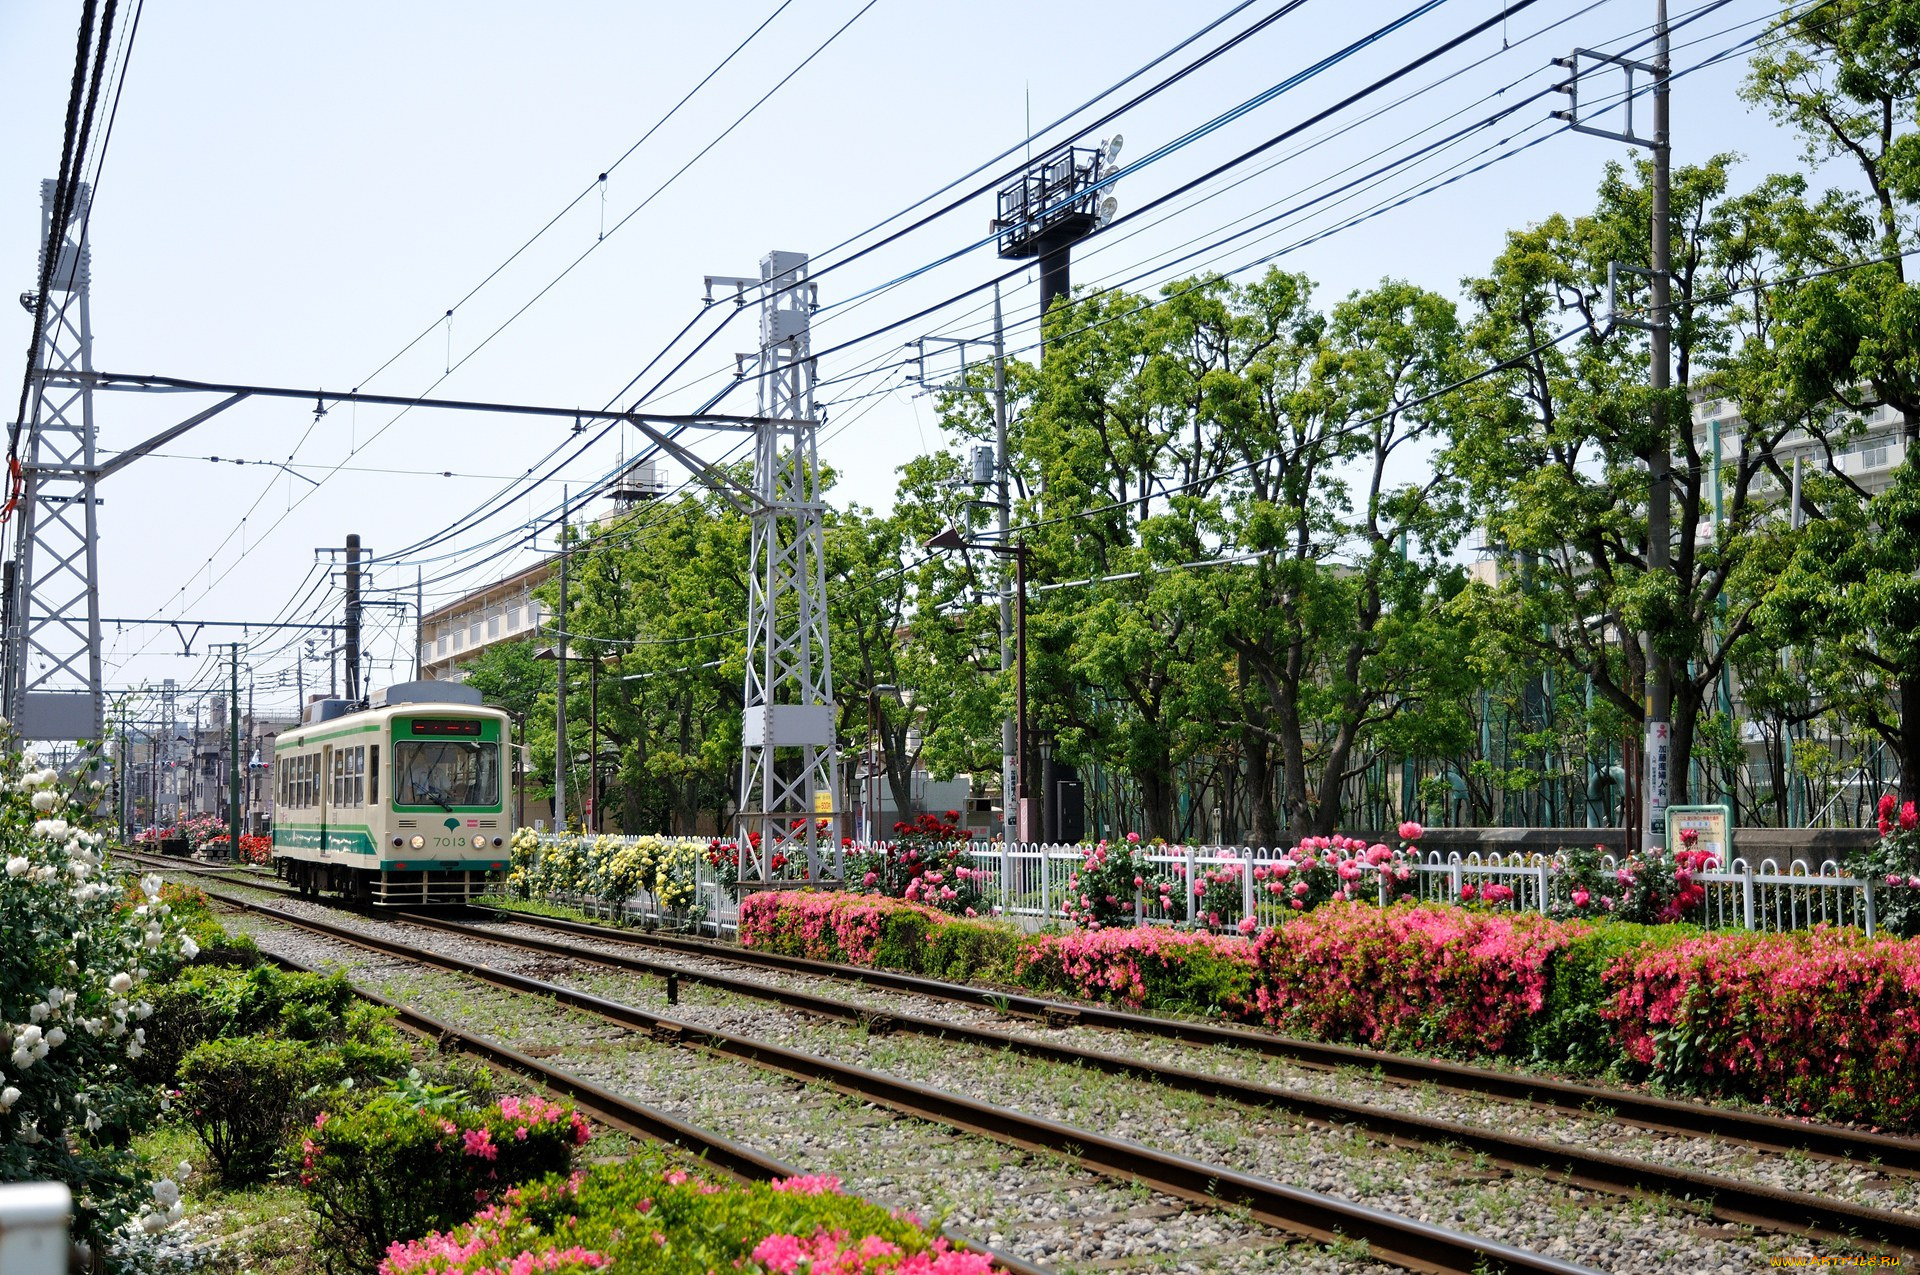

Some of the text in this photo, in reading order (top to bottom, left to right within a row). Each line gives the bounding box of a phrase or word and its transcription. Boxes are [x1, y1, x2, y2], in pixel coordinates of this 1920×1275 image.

[1658, 744, 1667, 797] 加藤産婦人科
[433, 837, 466, 847] 7013
